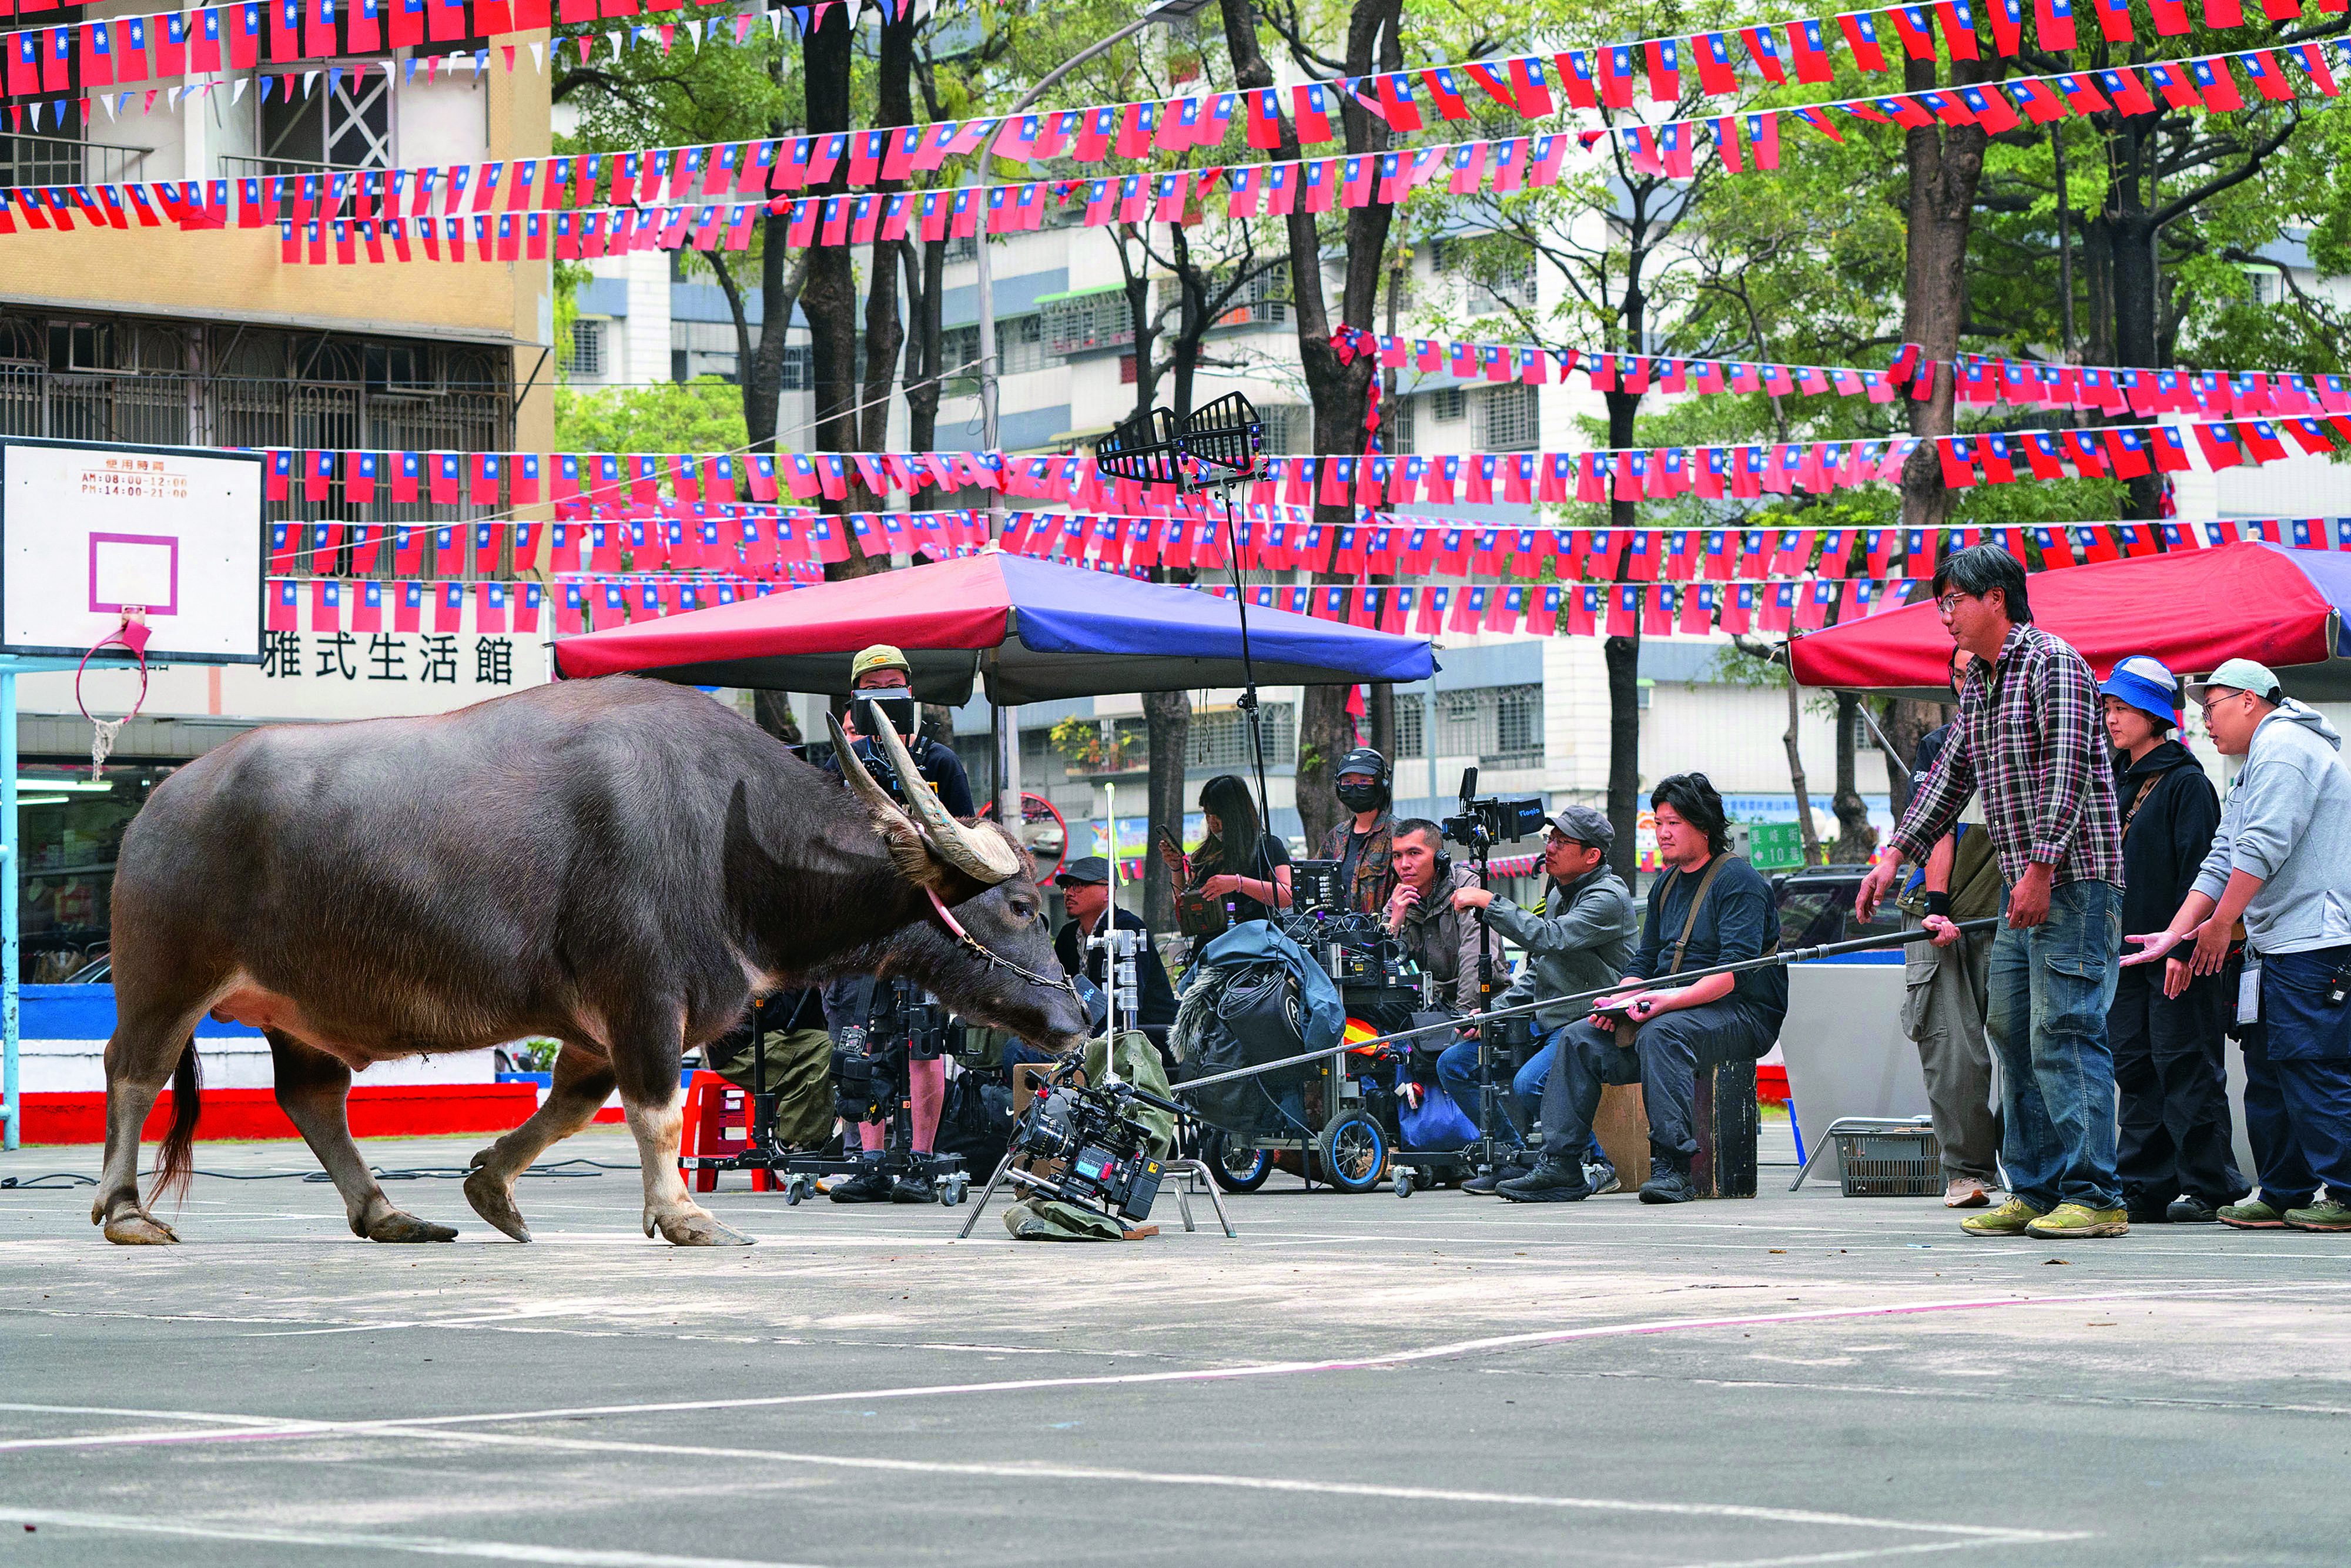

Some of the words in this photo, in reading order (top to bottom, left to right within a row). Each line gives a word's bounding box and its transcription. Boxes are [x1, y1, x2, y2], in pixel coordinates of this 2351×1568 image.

[106, 459, 164, 471] 使用時間
[82, 473, 187, 487] AM:08:00-12:00
[82, 484, 187, 498] PM:14:00-21:00
[260, 630, 513, 685] 雅式生活館
